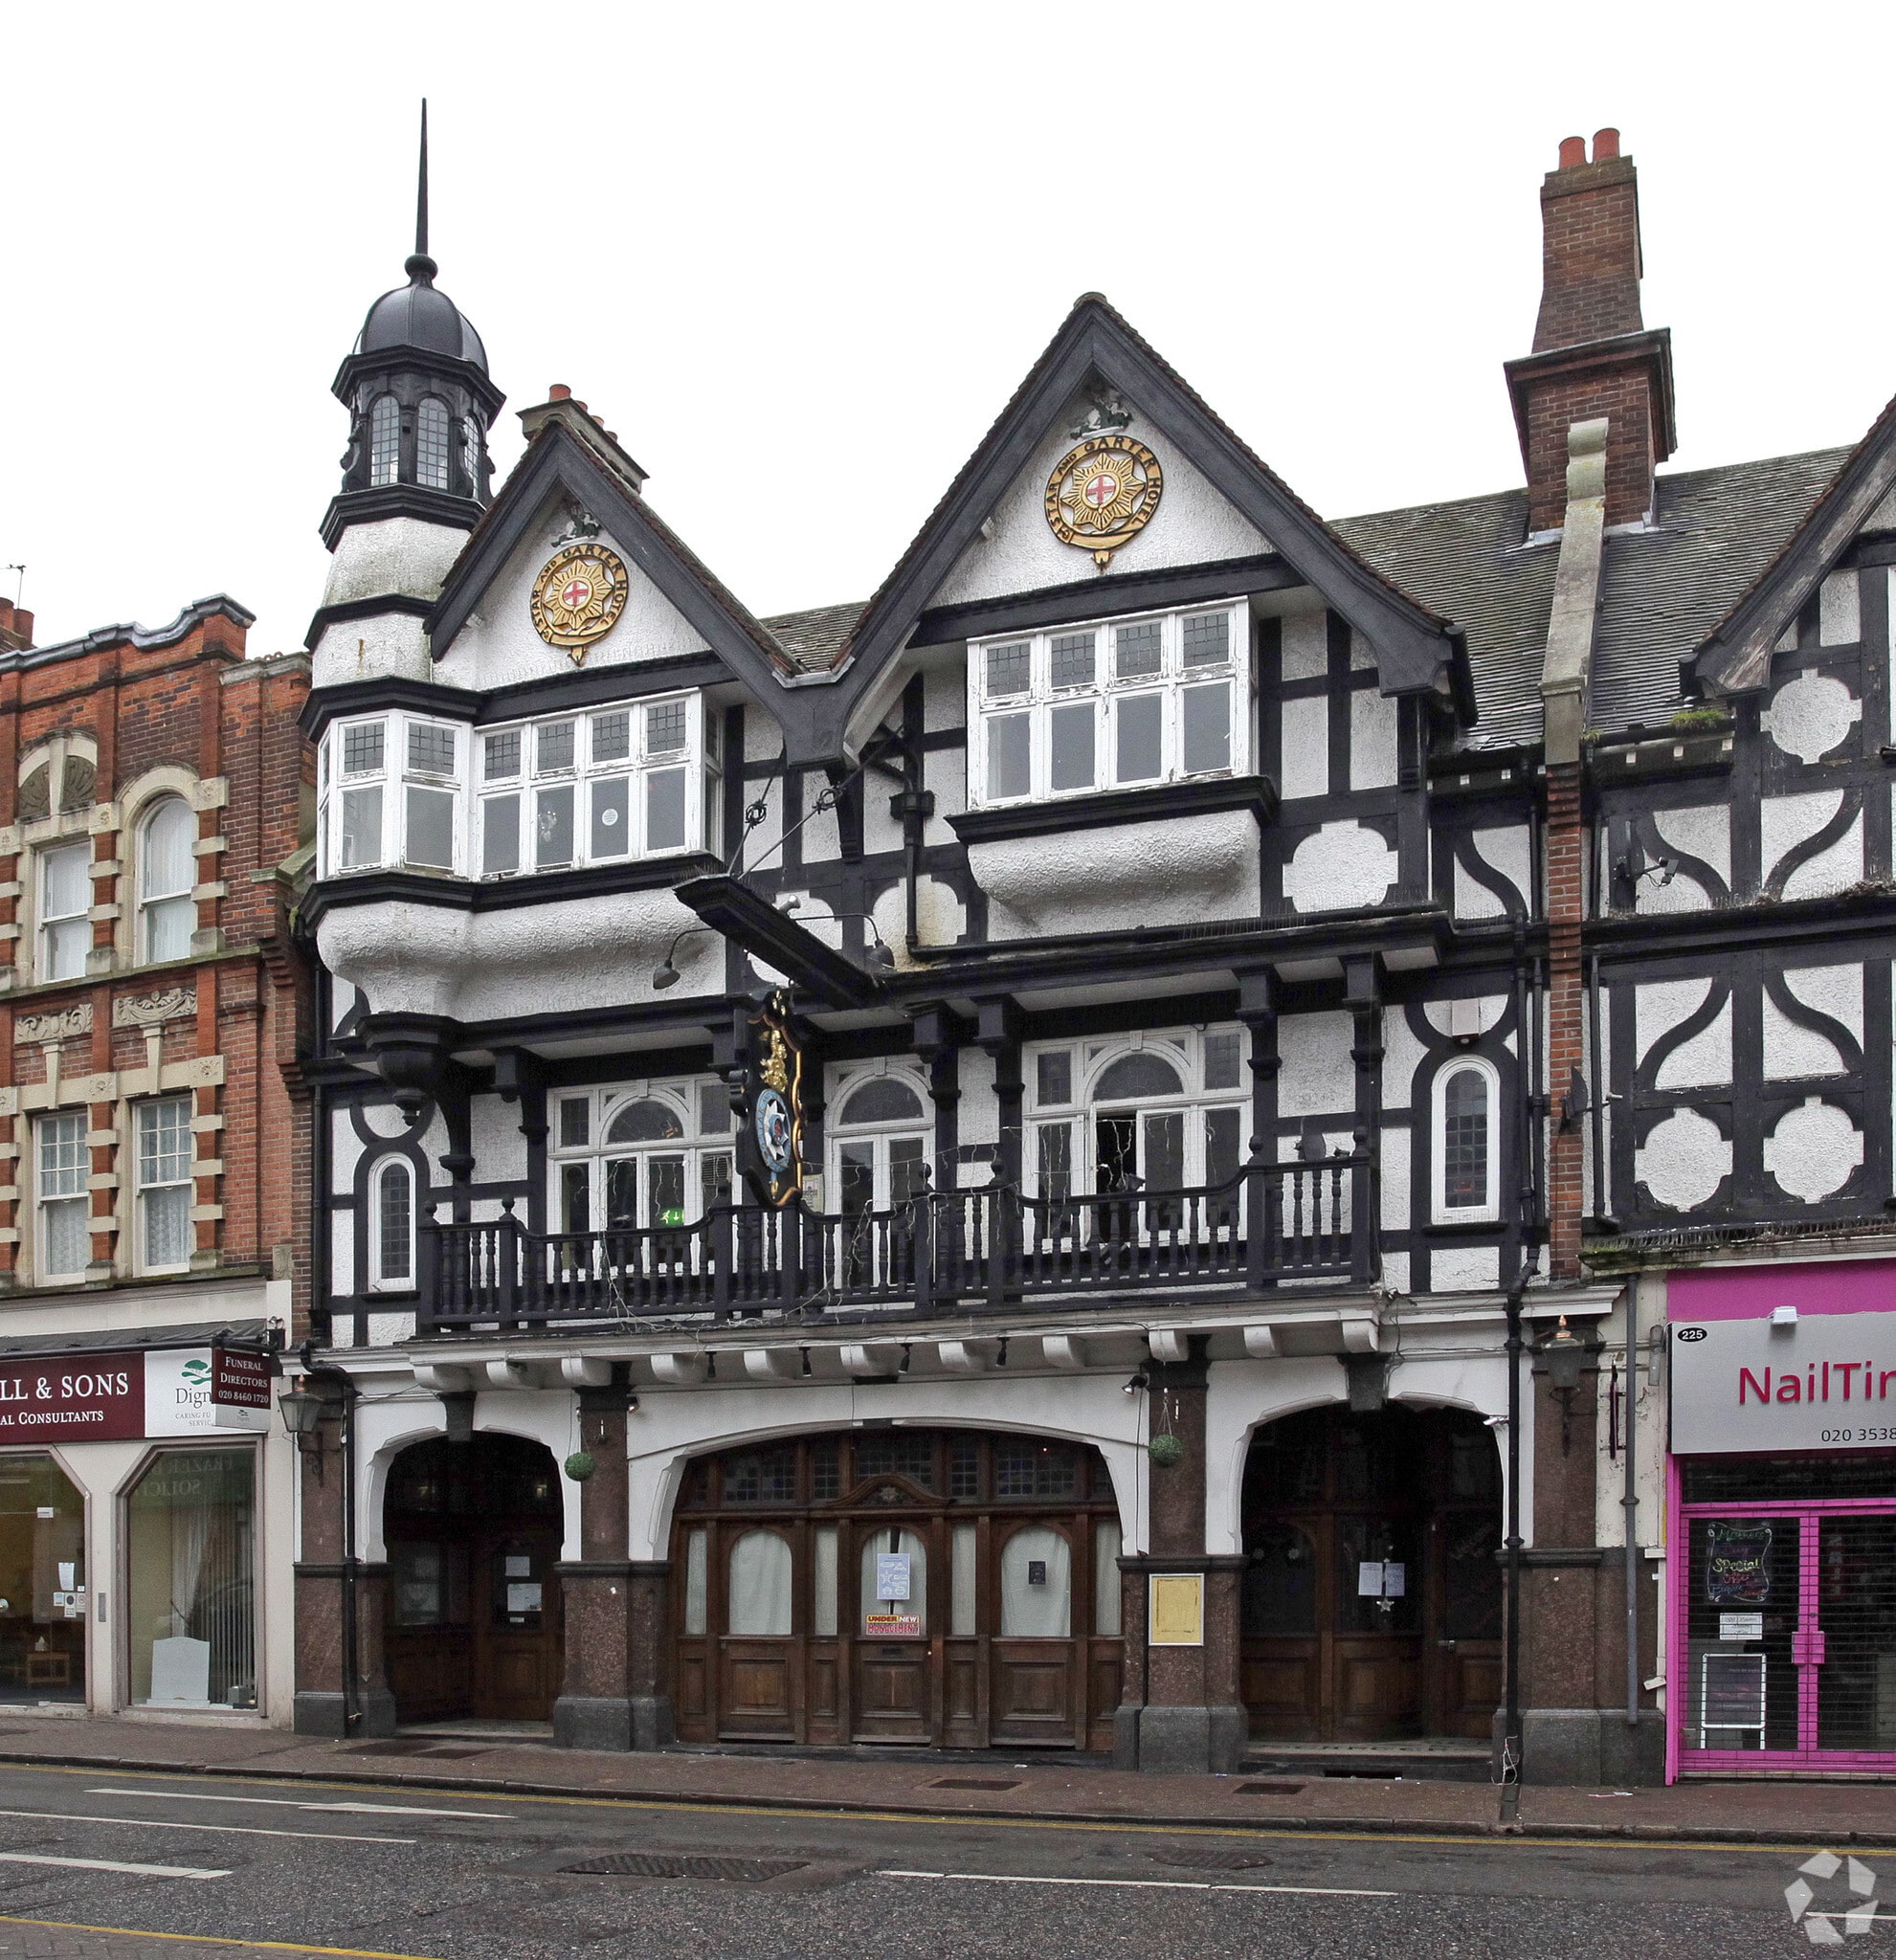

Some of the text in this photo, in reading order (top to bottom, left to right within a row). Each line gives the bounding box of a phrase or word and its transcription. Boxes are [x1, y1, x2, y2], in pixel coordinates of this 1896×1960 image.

[1046, 436, 1160, 528] STAR AND GARTER HOTEL
[531, 546, 627, 627] STAR AND GARTER HOTEL
[1682, 1329, 1703, 1340] 225
[225, 1356, 263, 1371] FUNERAL
[35, 1377, 53, 1399] &
[61, 1372, 128, 1398] SONS
[220, 1372, 268, 1388] DIRECTORS
[218, 1390, 269, 1404] 020 8460 1720
[1821, 1429, 1852, 1441] 020
[868, 1623, 918, 1634] MANAGEMENT
